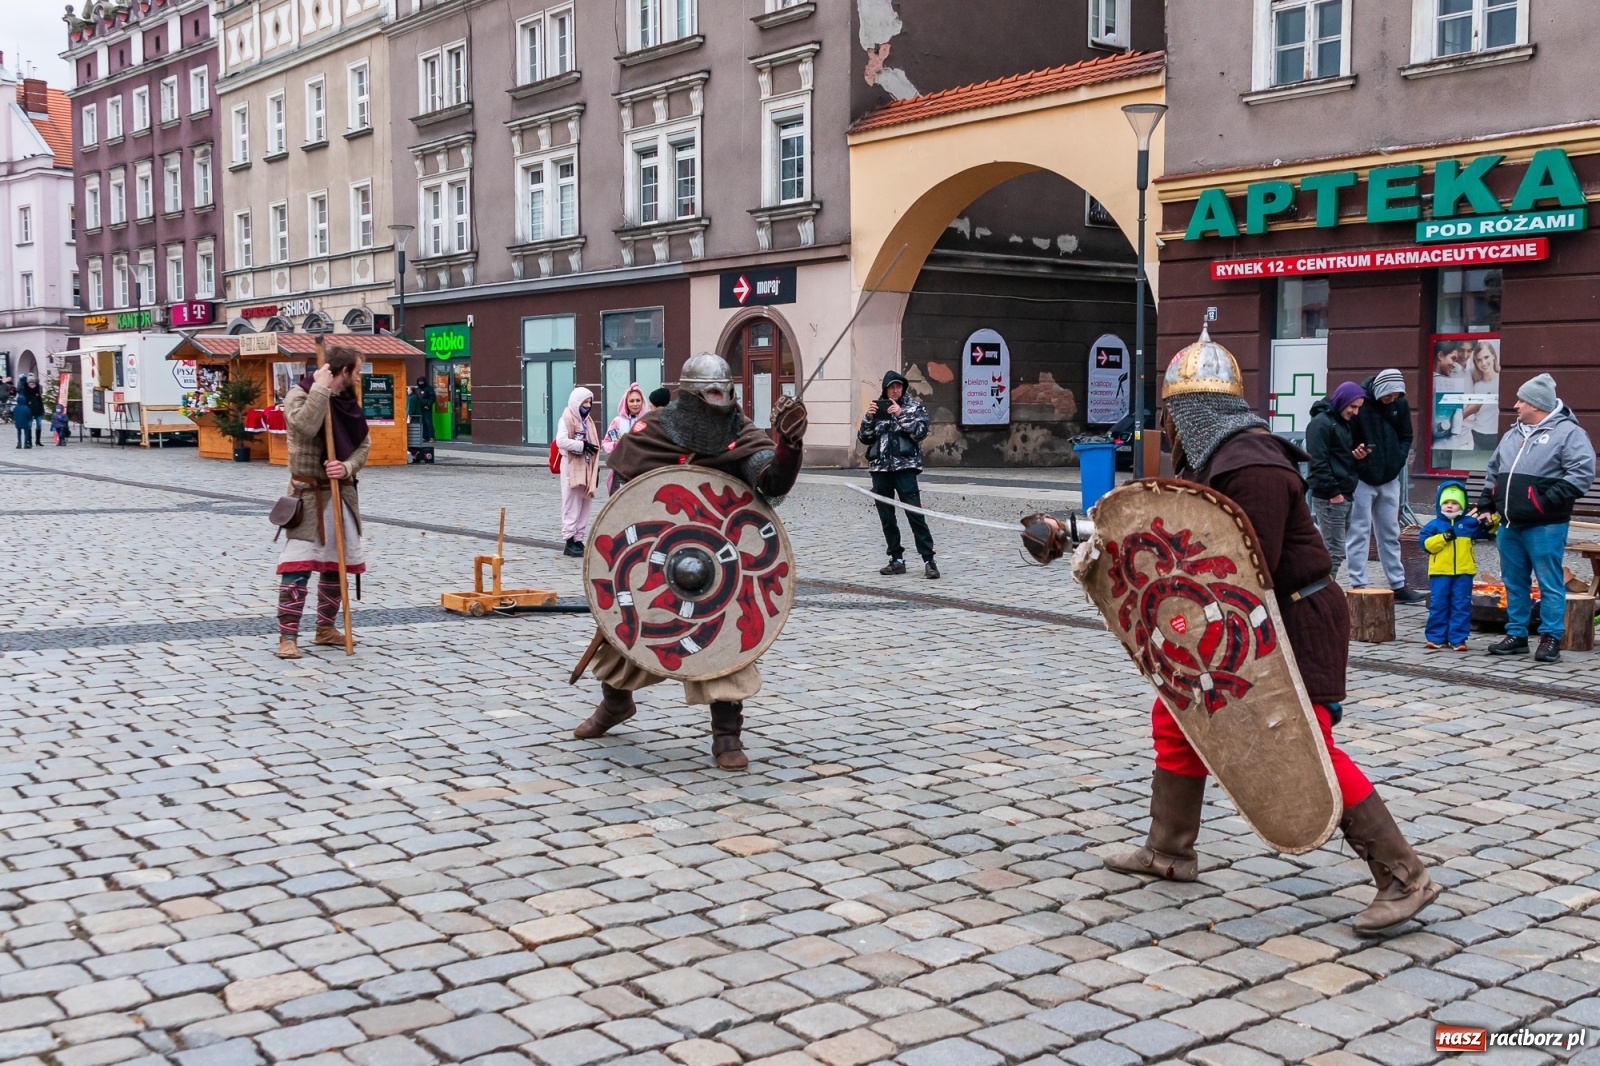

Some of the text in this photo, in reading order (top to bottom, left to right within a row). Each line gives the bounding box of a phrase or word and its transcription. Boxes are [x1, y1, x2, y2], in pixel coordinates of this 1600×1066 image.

[1184, 148, 1588, 241] APTEKA
[1425, 213, 1575, 238] POD RÓŻAMI
[1216, 262, 1264, 277] RYNEK
[1267, 260, 1285, 273] 12
[1296, 254, 1371, 271] CENTRUM
[1375, 243, 1538, 266] FARMACEUTYCZNE
[756, 276, 781, 296] moraj
[285, 299, 312, 317] SHIRO
[84, 316, 107, 326] TABAC
[431, 332, 465, 351] żabka
